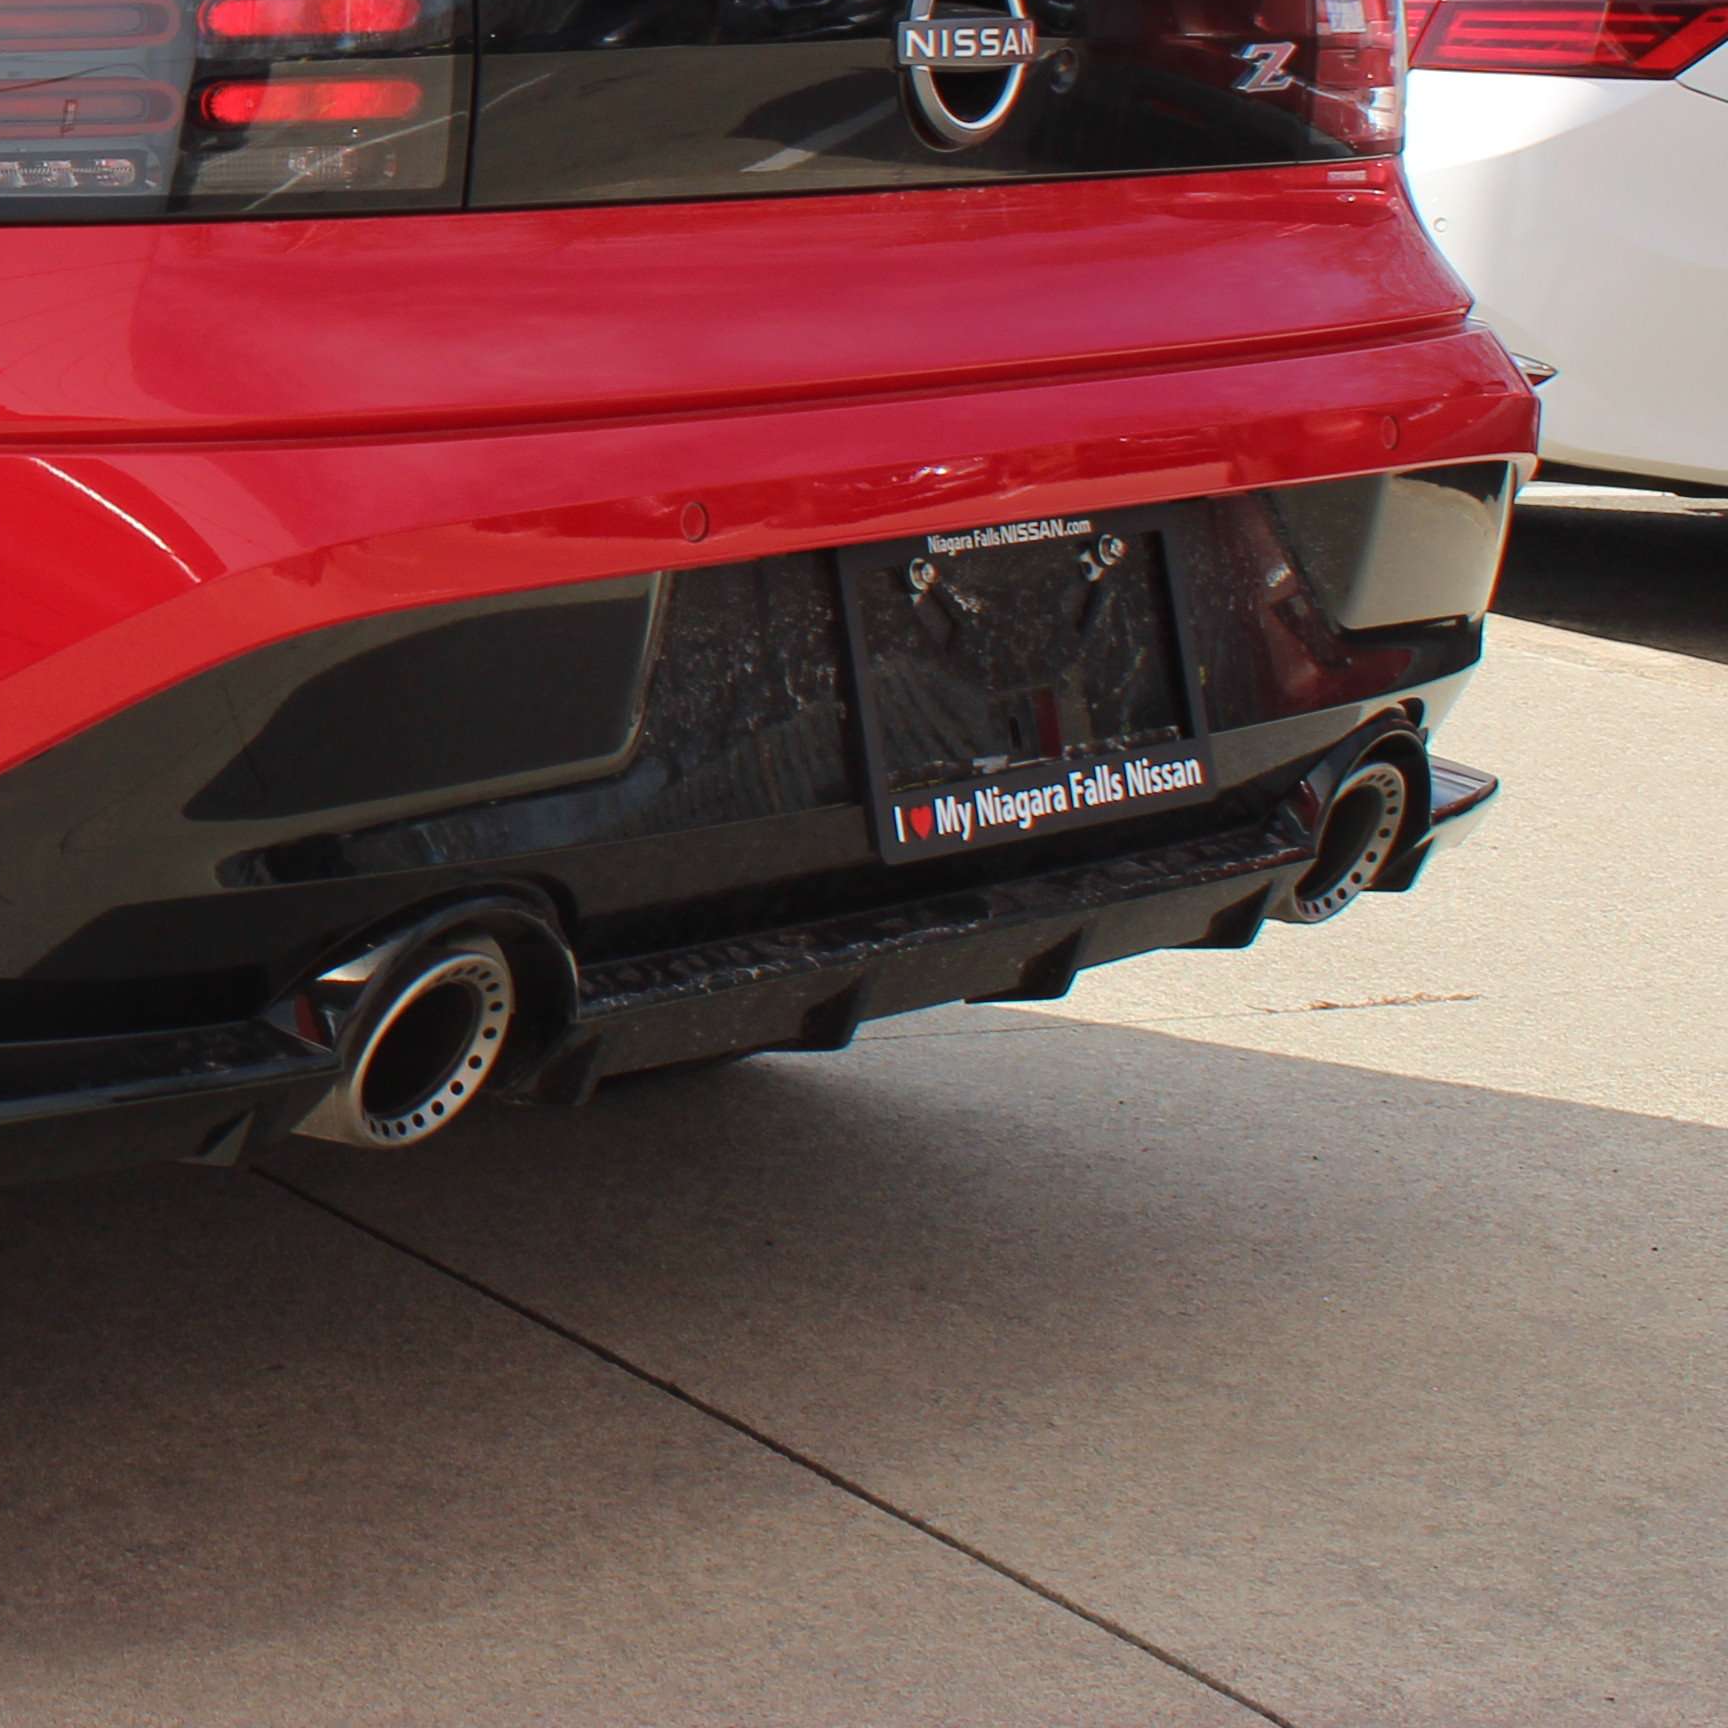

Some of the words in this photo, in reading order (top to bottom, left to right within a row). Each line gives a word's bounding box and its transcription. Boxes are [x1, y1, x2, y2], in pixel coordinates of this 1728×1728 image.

[905, 26, 1033, 58] NISSAN
[927, 534, 974, 557] Niagara
[894, 805, 906, 843] I
[933, 795, 972, 841] My
[975, 786, 1069, 830] Niagara
[1069, 764, 1123, 809] Falls
[1125, 757, 1204, 798] Nissan
